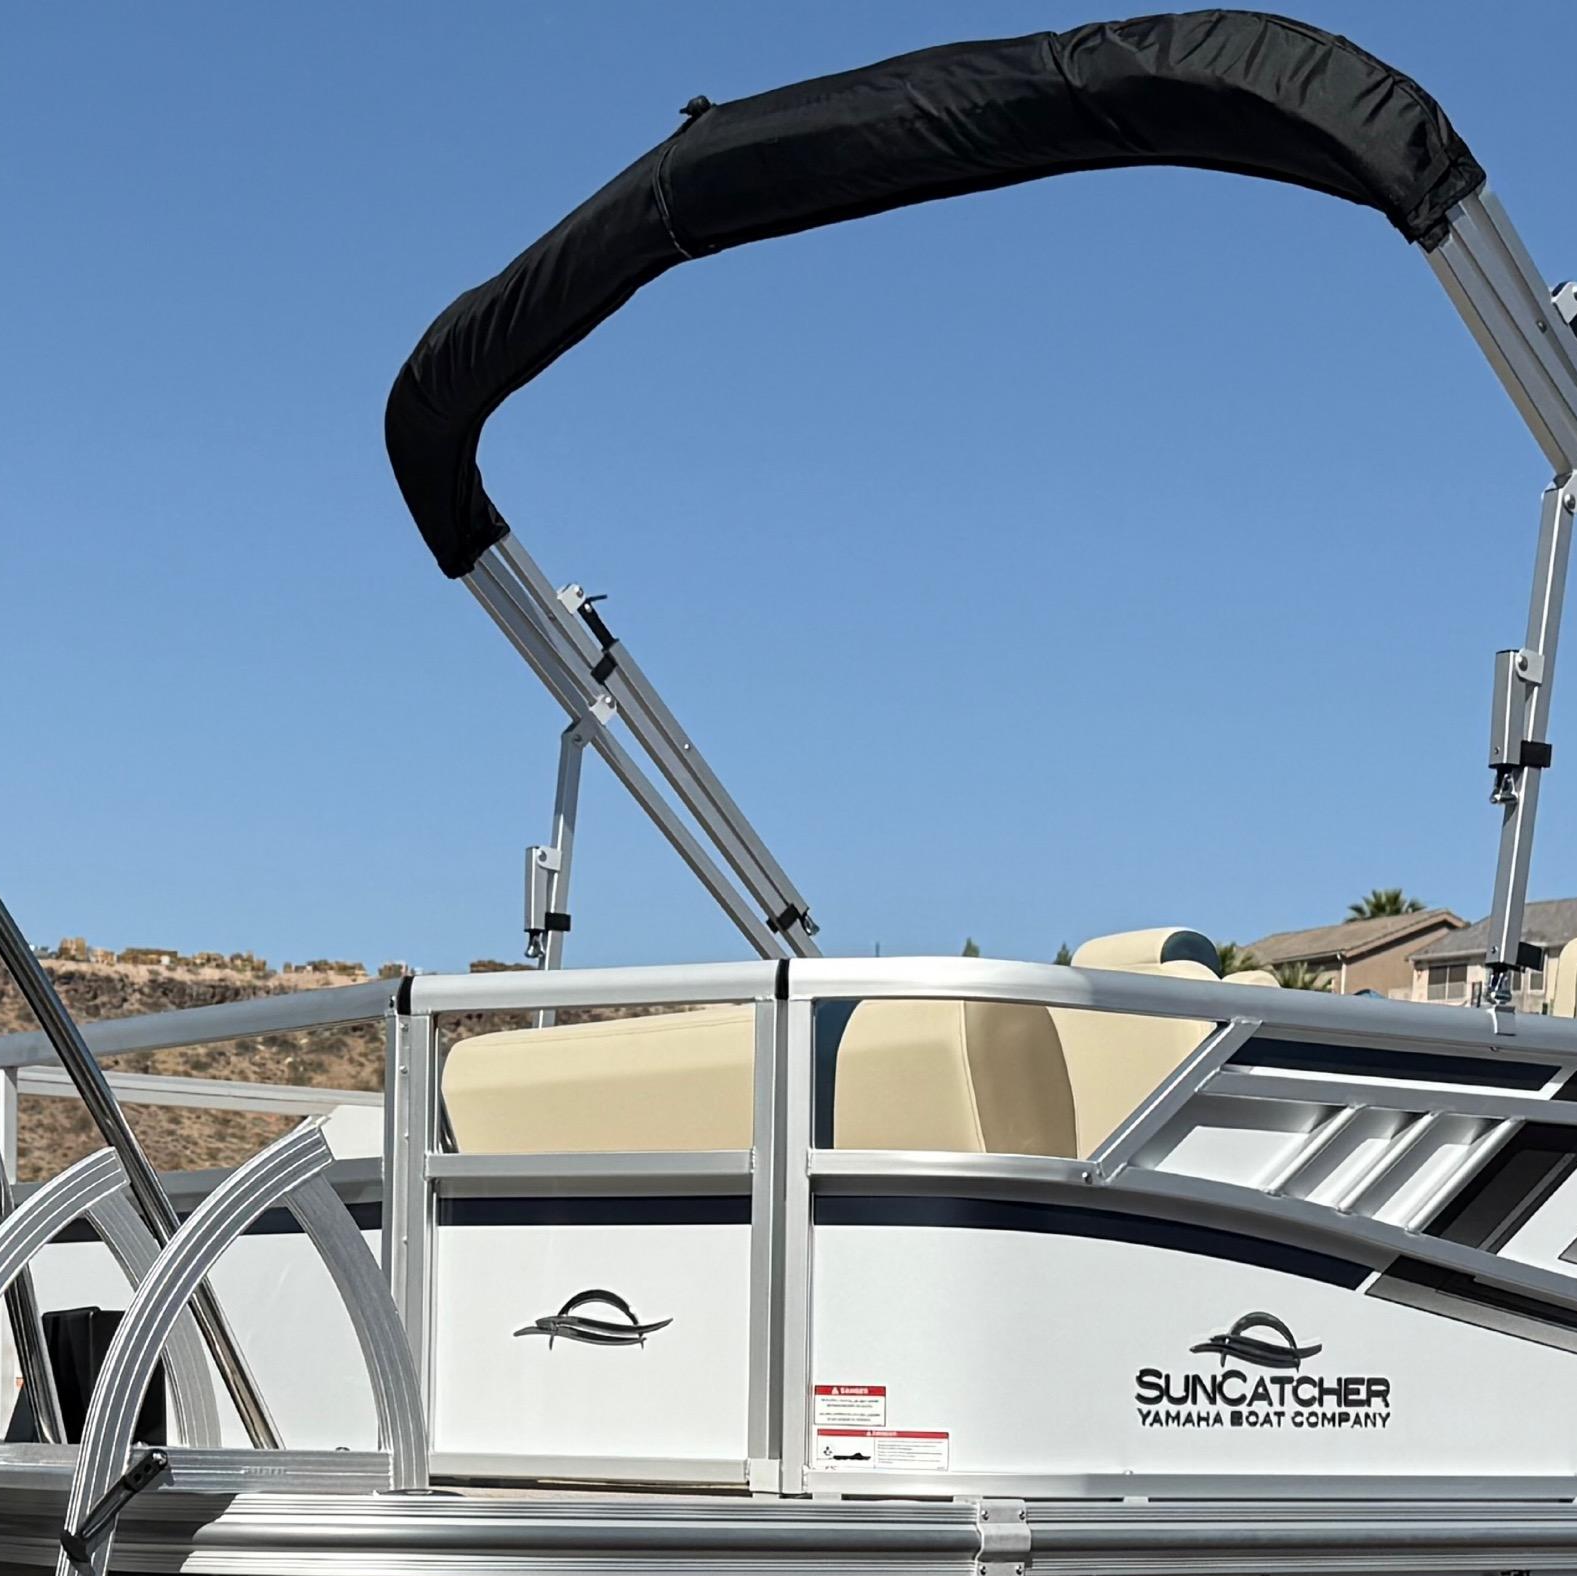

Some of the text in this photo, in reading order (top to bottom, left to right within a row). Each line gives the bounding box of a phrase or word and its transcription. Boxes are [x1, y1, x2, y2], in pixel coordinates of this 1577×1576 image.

[1137, 1408, 1391, 1429] YAMAHA BOAT COMPANY
